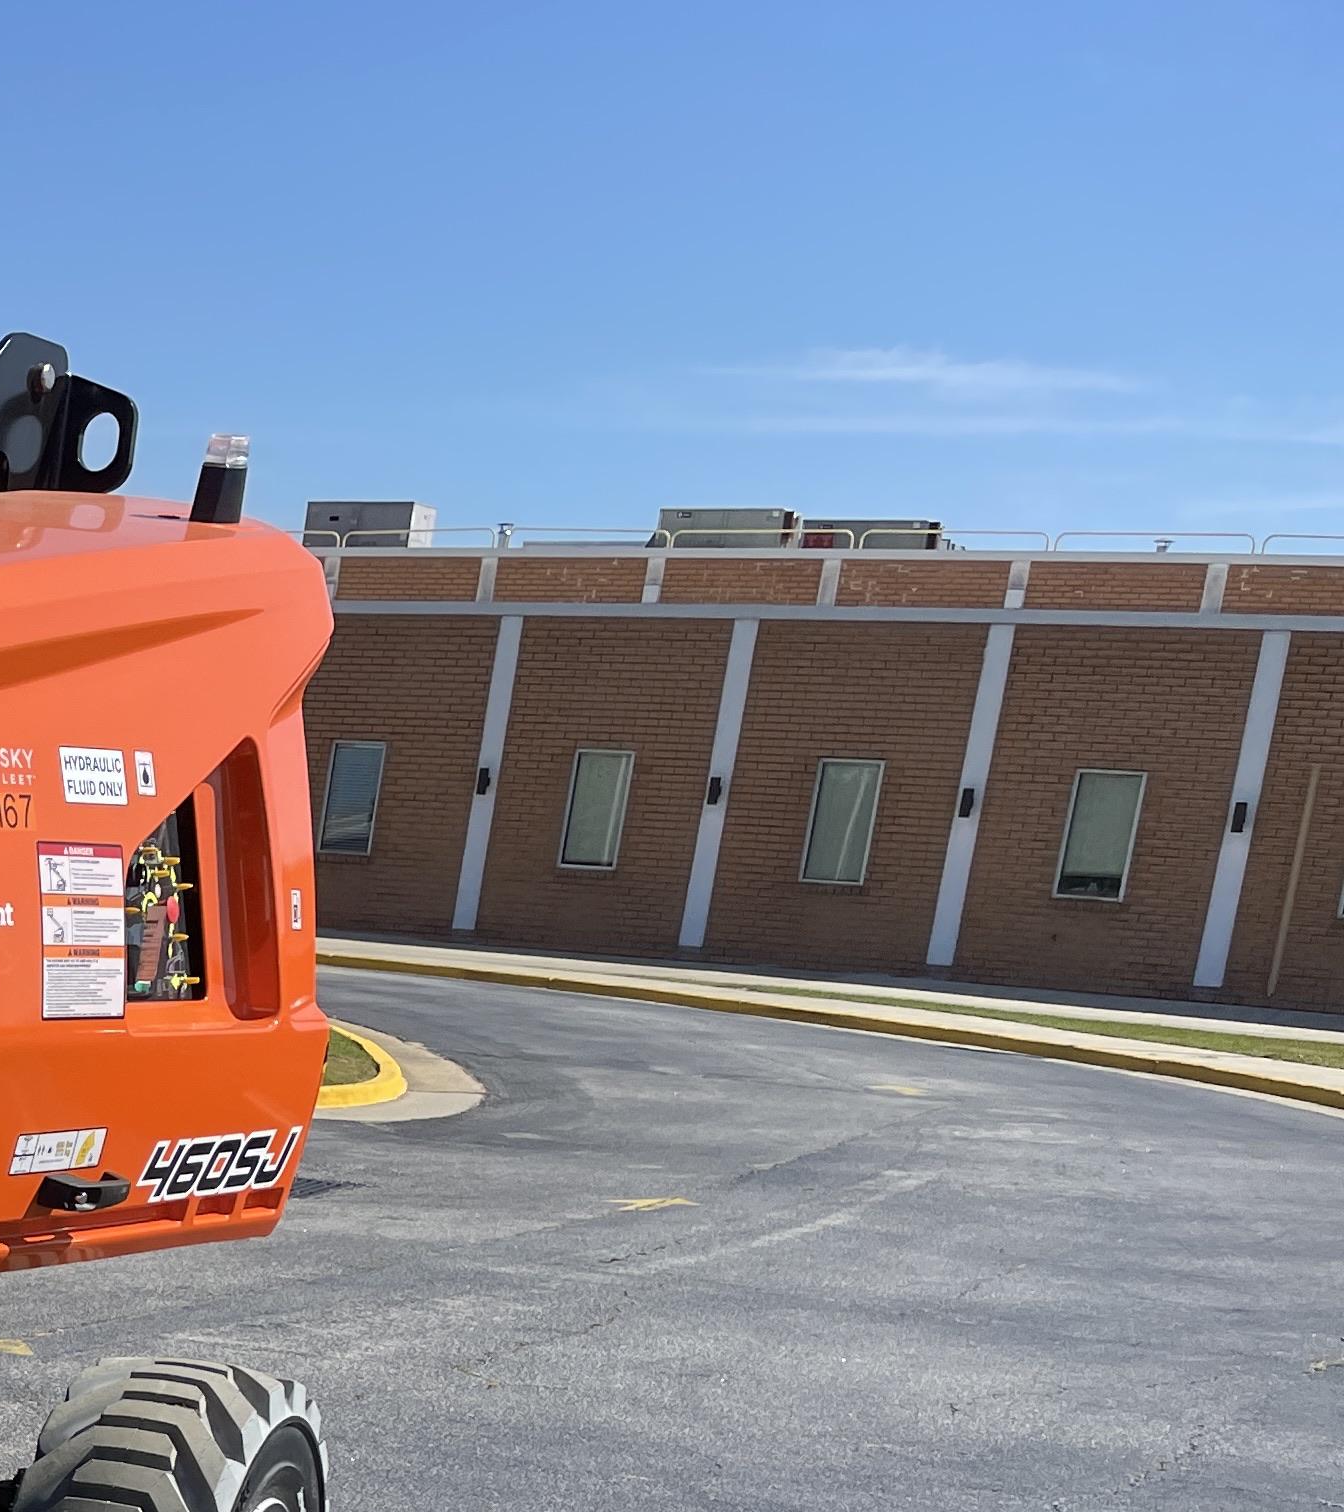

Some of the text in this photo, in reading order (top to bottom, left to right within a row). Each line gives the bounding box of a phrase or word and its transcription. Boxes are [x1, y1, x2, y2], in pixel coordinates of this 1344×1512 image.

[63, 755, 122, 773] HYDRAULIC
[67, 779, 123, 797] FLUID ONLY
